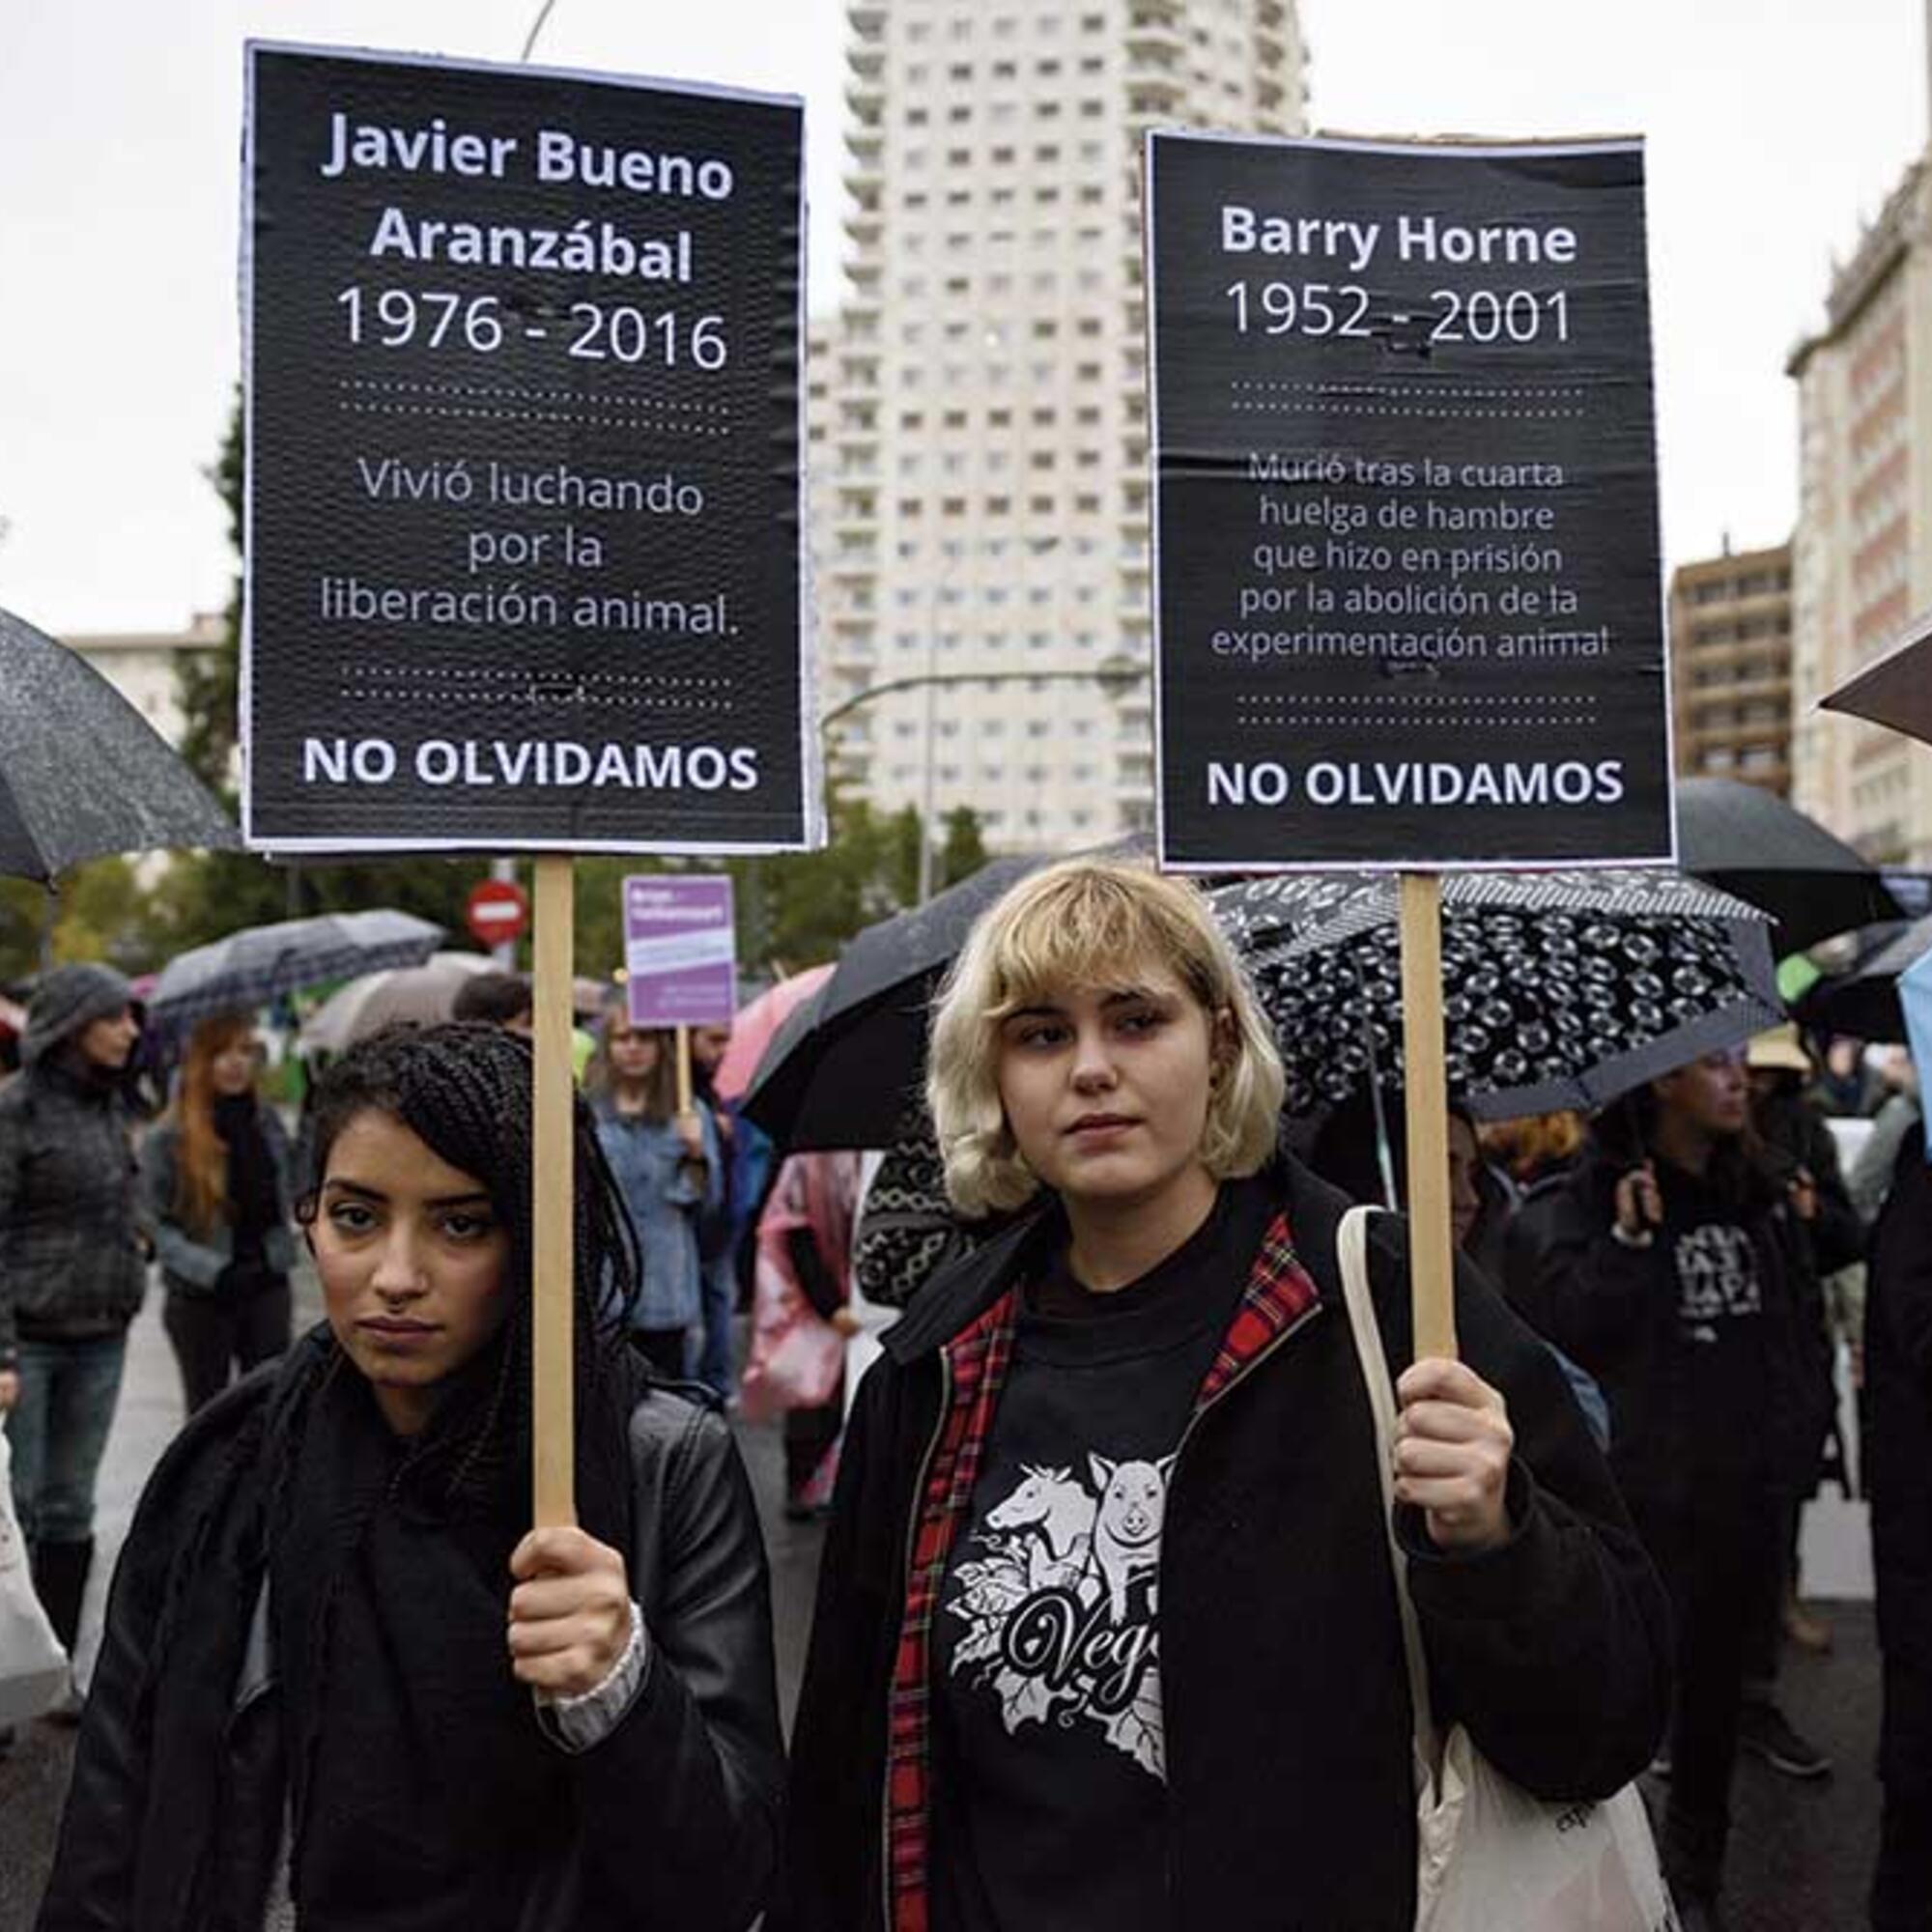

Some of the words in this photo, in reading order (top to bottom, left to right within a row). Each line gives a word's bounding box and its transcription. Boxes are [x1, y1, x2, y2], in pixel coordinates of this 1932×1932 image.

[322, 113, 516, 178] Javier
[537, 130, 733, 198] Bueno
[369, 207, 691, 282] Aranzábal
[1222, 206, 1378, 270] Barry
[1398, 215, 1577, 262] Horne
[337, 286, 503, 352] 1976
[526, 328, 546, 338] -
[568, 301, 725, 369] 2016
[1226, 281, 1371, 336] 1952
[1430, 289, 1568, 343] 2001
[358, 457, 472, 500] Vivió
[491, 463, 701, 516] luchando
[1248, 452, 1345, 481] Murió
[1354, 459, 1415, 486] tras
[1425, 458, 1451, 486] la
[1462, 462, 1563, 486] cuarta
[1261, 495, 1367, 533] huelga
[1378, 499, 1416, 527] de
[1429, 500, 1553, 530] hambre
[469, 531, 549, 572] por
[566, 526, 602, 566] la
[1255, 545, 1316, 574] que
[1326, 541, 1391, 570] hizo
[1402, 548, 1439, 570] en
[1452, 543, 1562, 579] prisión
[322, 579, 555, 625] liberación
[574, 590, 738, 635] animal.
[1240, 588, 1296, 618] por
[1307, 581, 1333, 612] la
[1344, 583, 1488, 615] abolición
[1499, 585, 1538, 615] de
[1551, 585, 1577, 615] la
[1212, 626, 1486, 662] experimentación
[1497, 626, 1608, 657] animal
[304, 737, 395, 783] NO
[415, 739, 757, 790] OLVIDAMOS
[1208, 761, 1288, 805] NO
[1306, 759, 1623, 804] OLVIDAMOS
[1009, 1595, 1157, 1704] Veg
